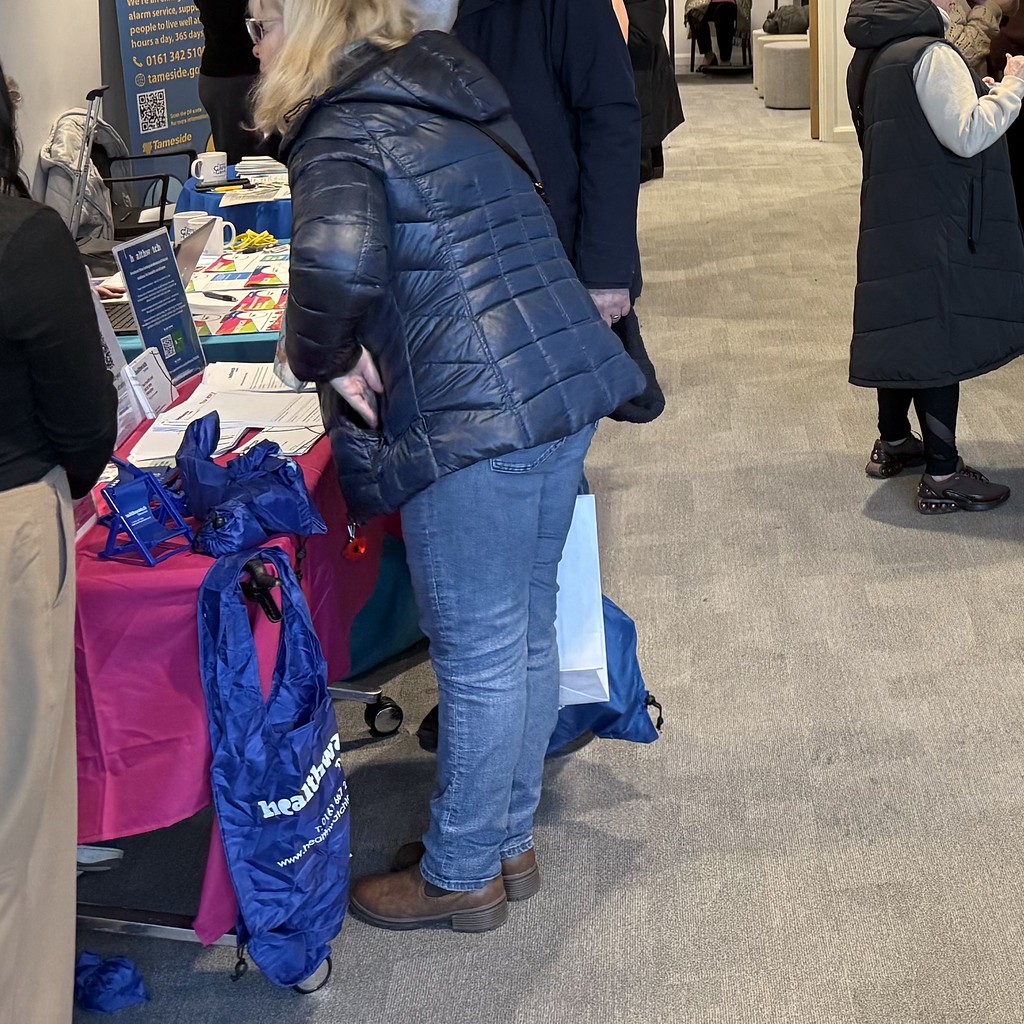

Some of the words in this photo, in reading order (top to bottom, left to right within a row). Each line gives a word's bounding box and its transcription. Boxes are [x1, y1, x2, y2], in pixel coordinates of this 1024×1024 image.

[128, 11, 151, 21] alarm
[152, 6, 178, 18] service,
[130, 23, 157, 36] people
[157, 22, 165, 30] to
[165, 19, 178, 29] live
[178, 17, 193, 26] well
[131, 38, 154, 49] hours
[175, 31, 187, 41] 365
[146, 52, 168, 66] 0161
[169, 49, 186, 62] 342
[148, 65, 201, 84] tameside.go
[154, 133, 192, 149] Tameside
